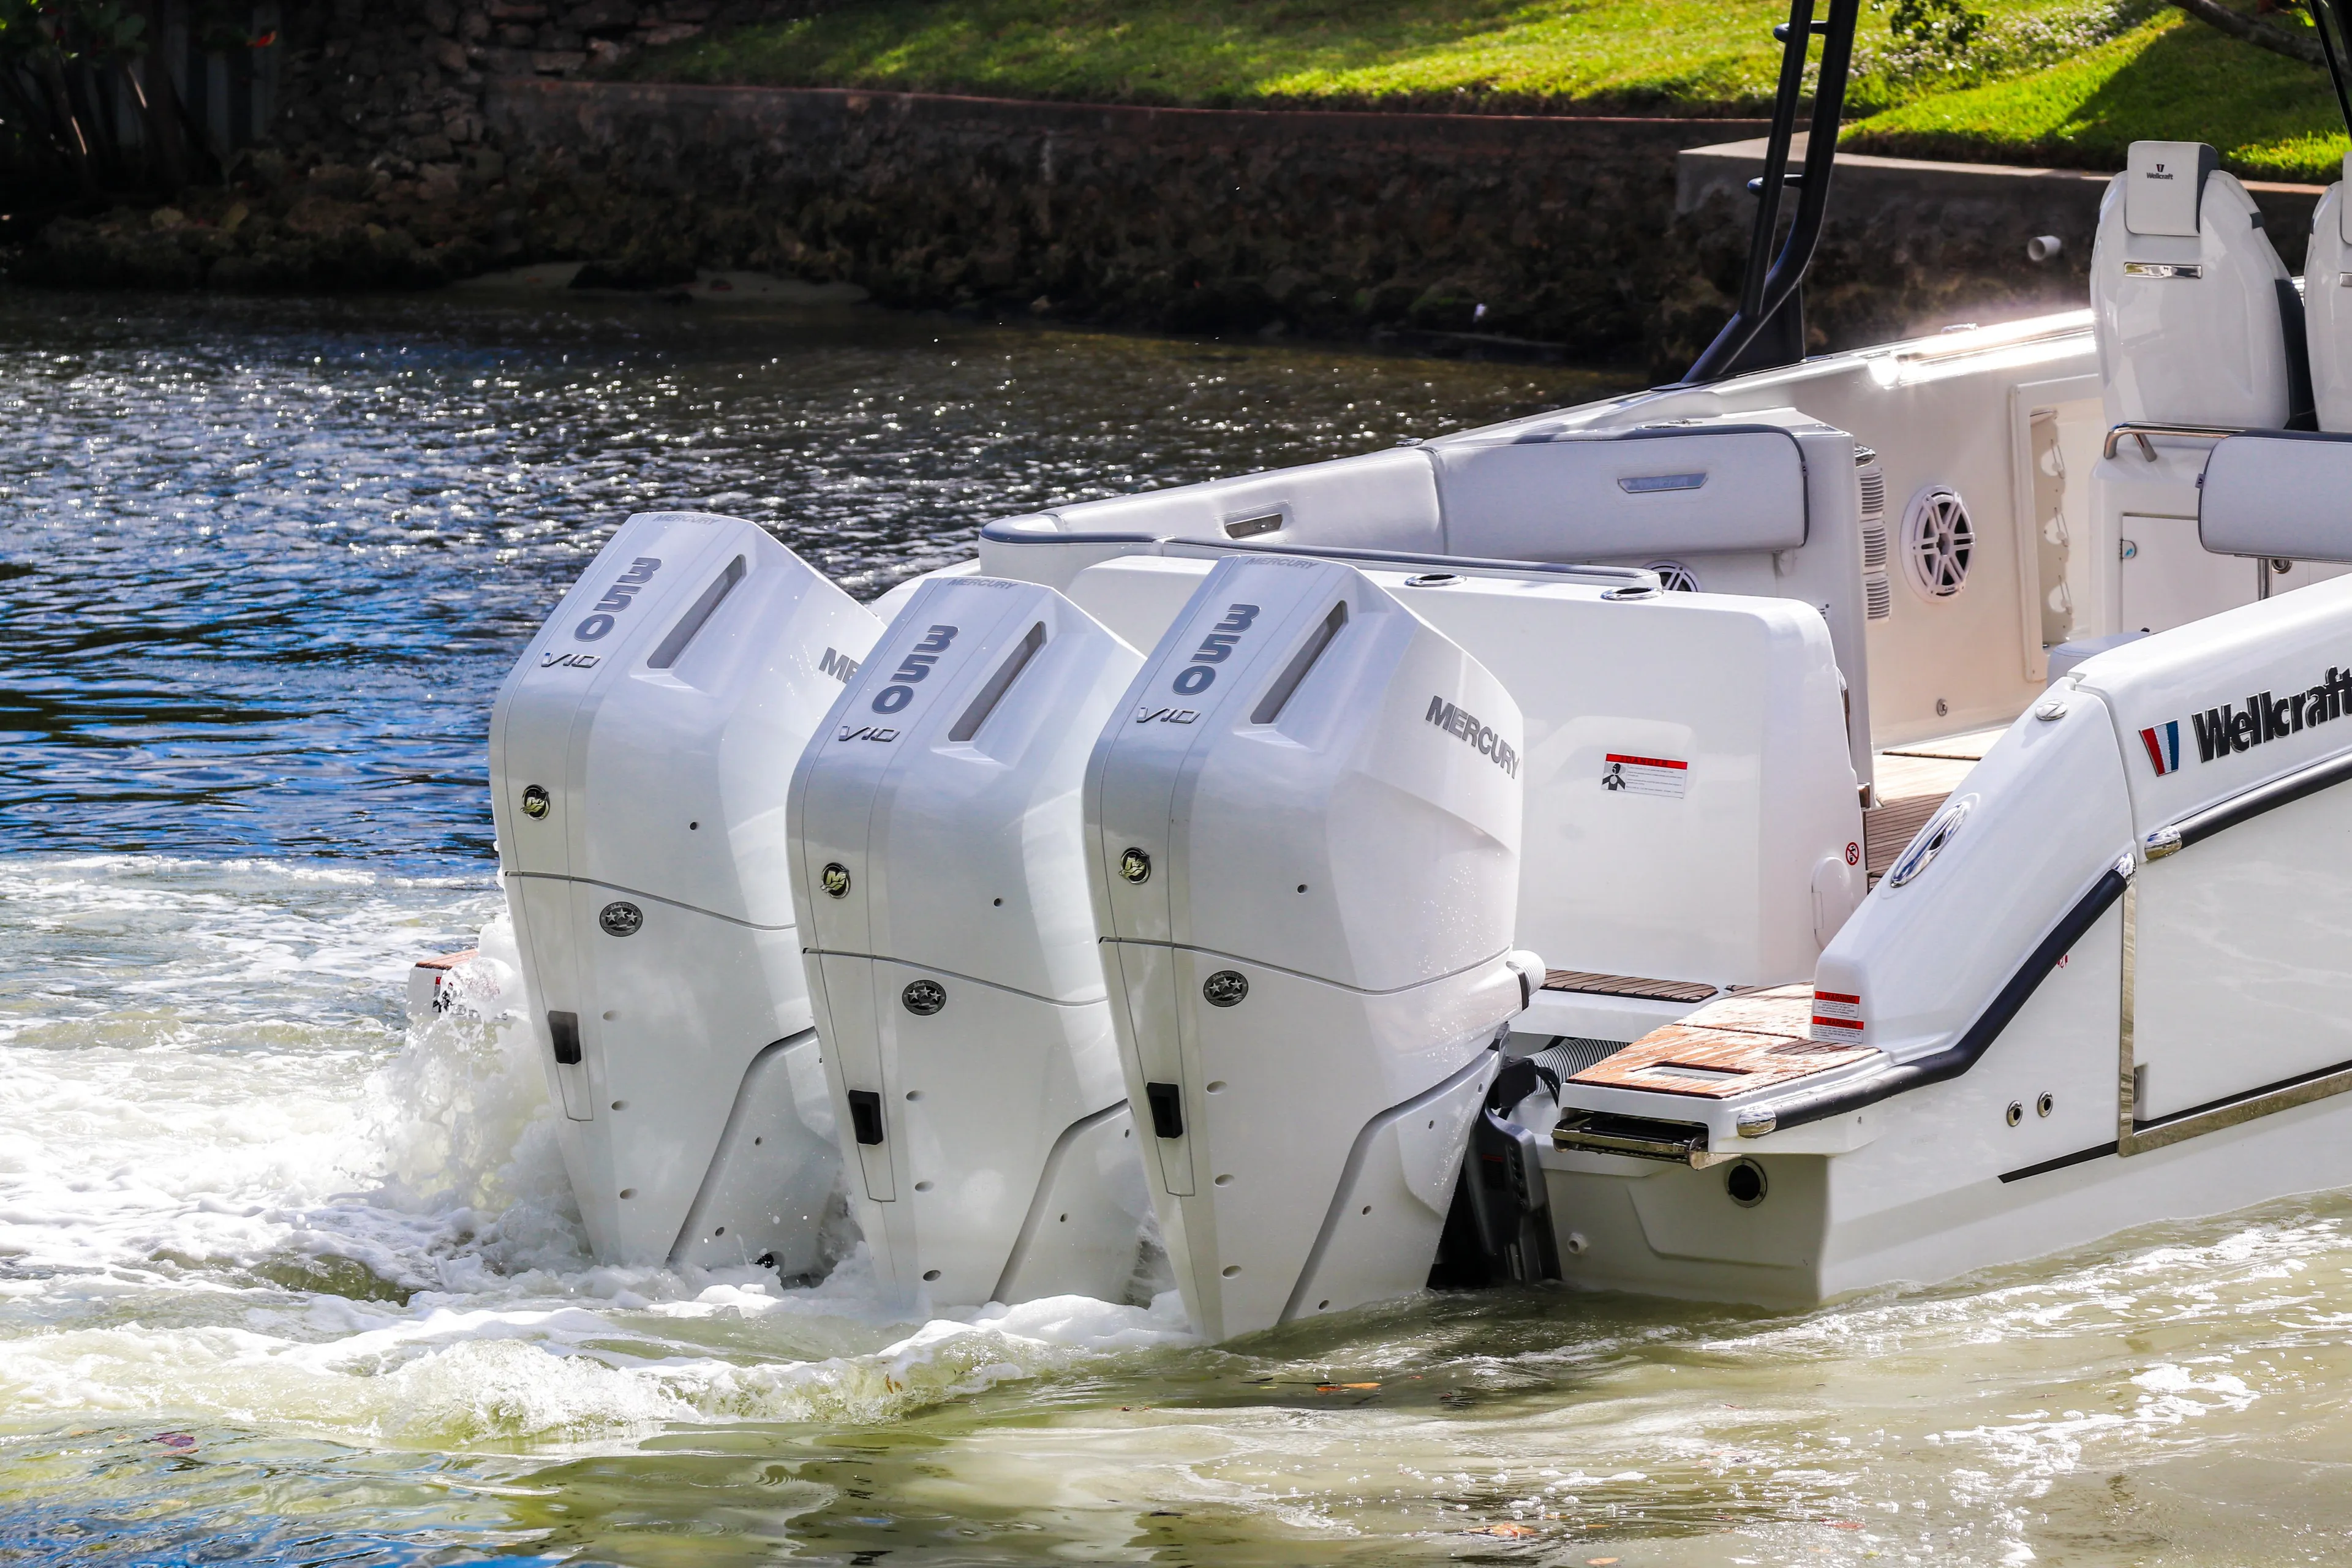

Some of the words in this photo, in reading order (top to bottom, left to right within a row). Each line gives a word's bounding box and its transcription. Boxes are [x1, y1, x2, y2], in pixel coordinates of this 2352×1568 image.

[2146, 172, 2174, 180] Wellcraft
[652, 514, 721, 526] MERCURY
[1245, 557, 1319, 570] MERCURY
[948, 578, 1019, 590] MERCURY
[573, 557, 663, 642] 350
[1171, 603, 1262, 696] 350
[541, 652, 601, 669] V10
[871, 624, 960, 715] 350
[1136, 706, 1201, 724] V10
[2191, 665, 2352, 763] Wellcraft
[838, 725, 901, 743] V10
[1425, 695, 1520, 780] MERCURY
[1825, 992, 1856, 1003] WARNING
[1825, 1018, 1858, 1028] WARNING
